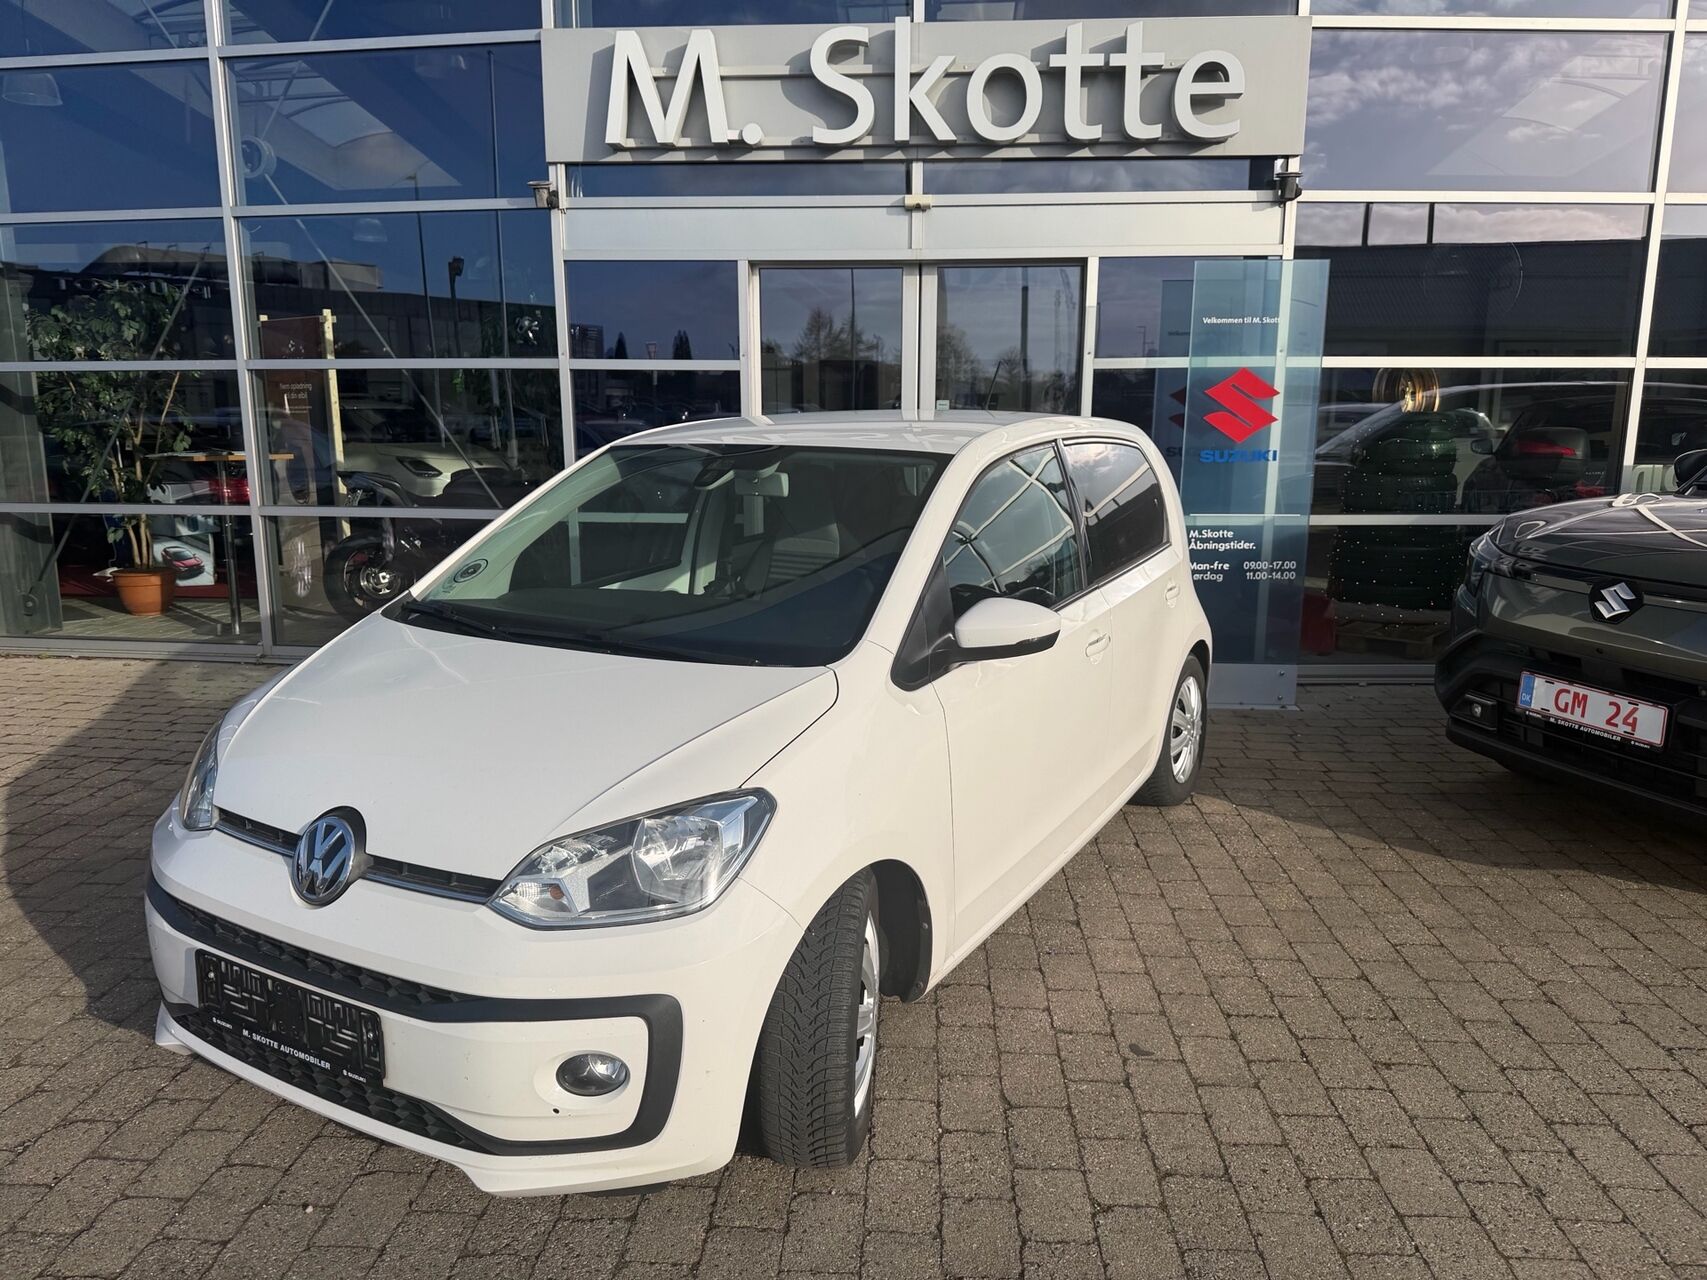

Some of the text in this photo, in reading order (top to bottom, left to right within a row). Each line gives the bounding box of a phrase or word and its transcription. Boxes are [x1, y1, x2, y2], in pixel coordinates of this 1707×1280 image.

[605, 16, 1245, 148] M. Skotte
[1202, 316, 1243, 324] Velkommen
[1244, 316, 1252, 324] til
[1200, 450, 1277, 462] SUZUKI
[1189, 529, 1234, 538] M.Skotte
[1188, 539, 1257, 552] Åbningstider.
[1243, 560, 1297, 571] 09.00-17.00
[1193, 571, 1296, 582] ørdag 11.00-14.00
[1521, 692, 1532, 703] DK
[1553, 687, 1639, 733] GM 24
[1557, 719, 1579, 730] SKOTTE
[1580, 726, 1621, 741] AUTOMOBILER
[242, 1027, 331, 1070] M. SKOTTE AUTOMOBILER
